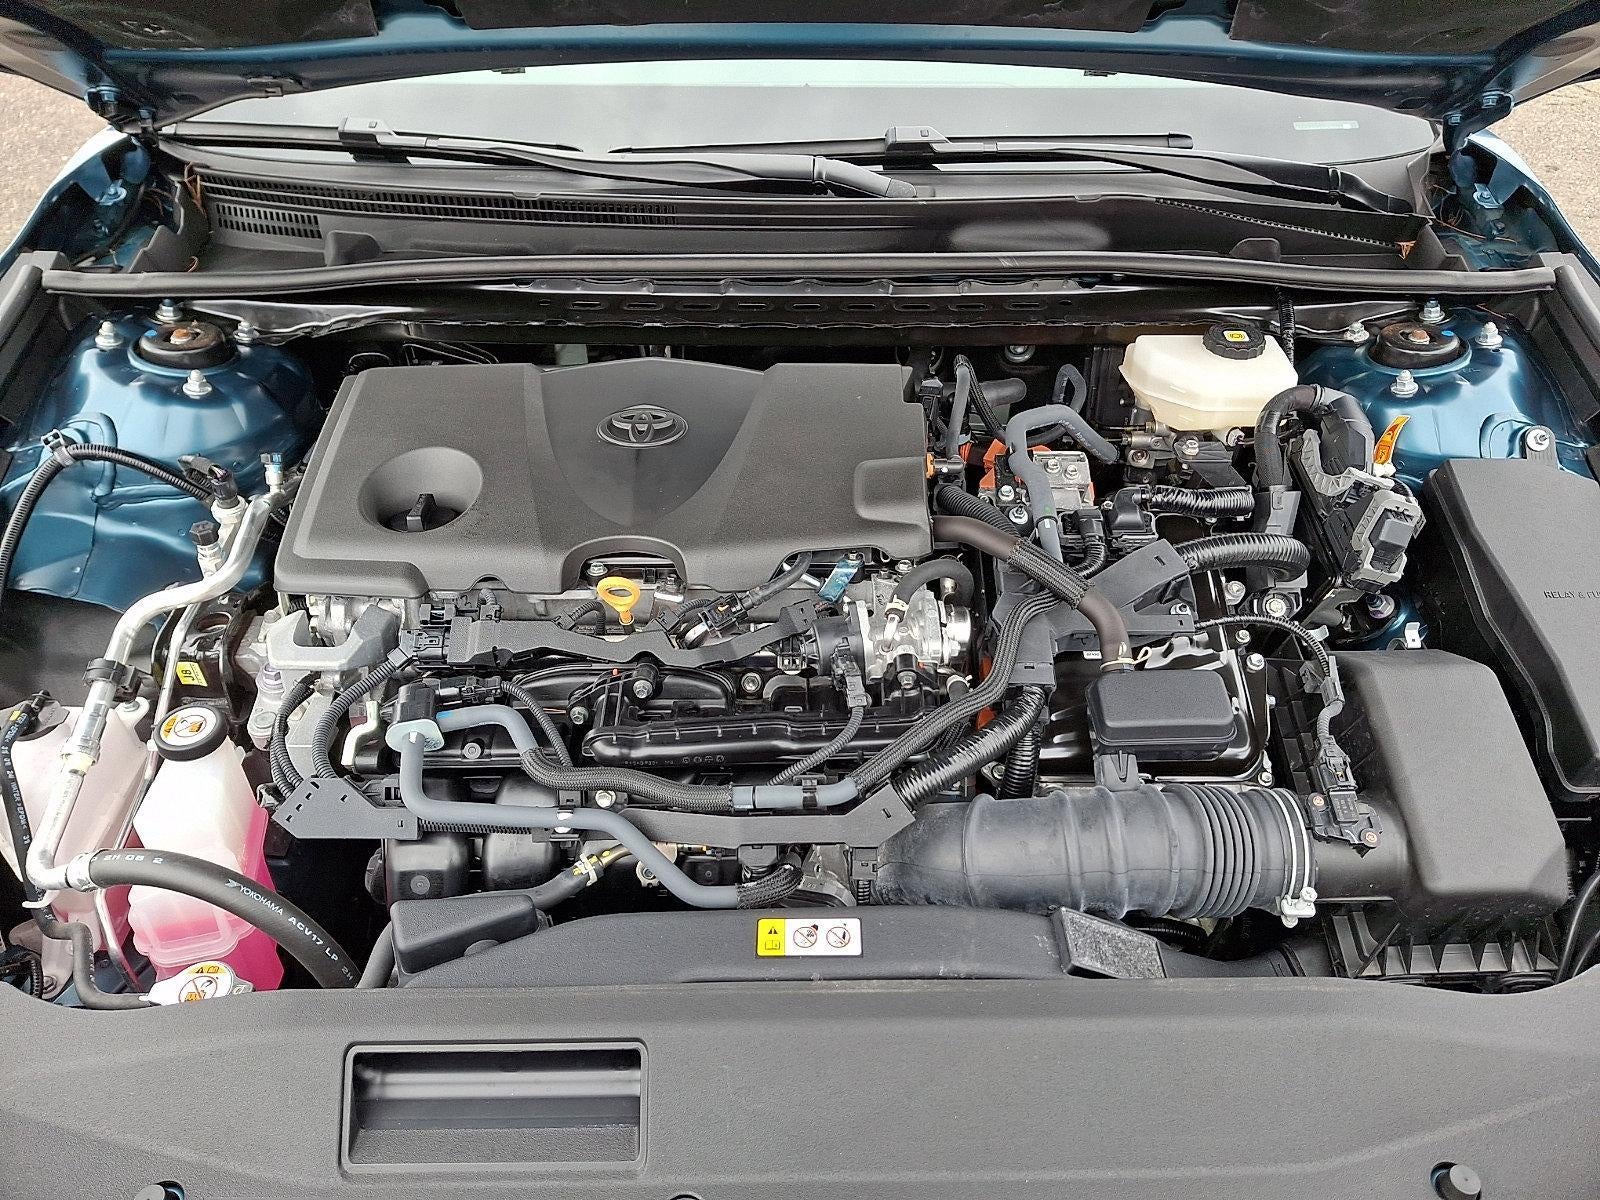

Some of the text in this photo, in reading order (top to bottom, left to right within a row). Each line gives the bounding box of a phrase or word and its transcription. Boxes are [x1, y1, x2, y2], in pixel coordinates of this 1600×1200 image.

[1543, 590, 1575, 599] RELAY
[1586, 590, 1600, 599] FU
[240, 884, 284, 915] YOKOHAMA
[288, 916, 324, 945] ACV17
[325, 947, 339, 961] LP
